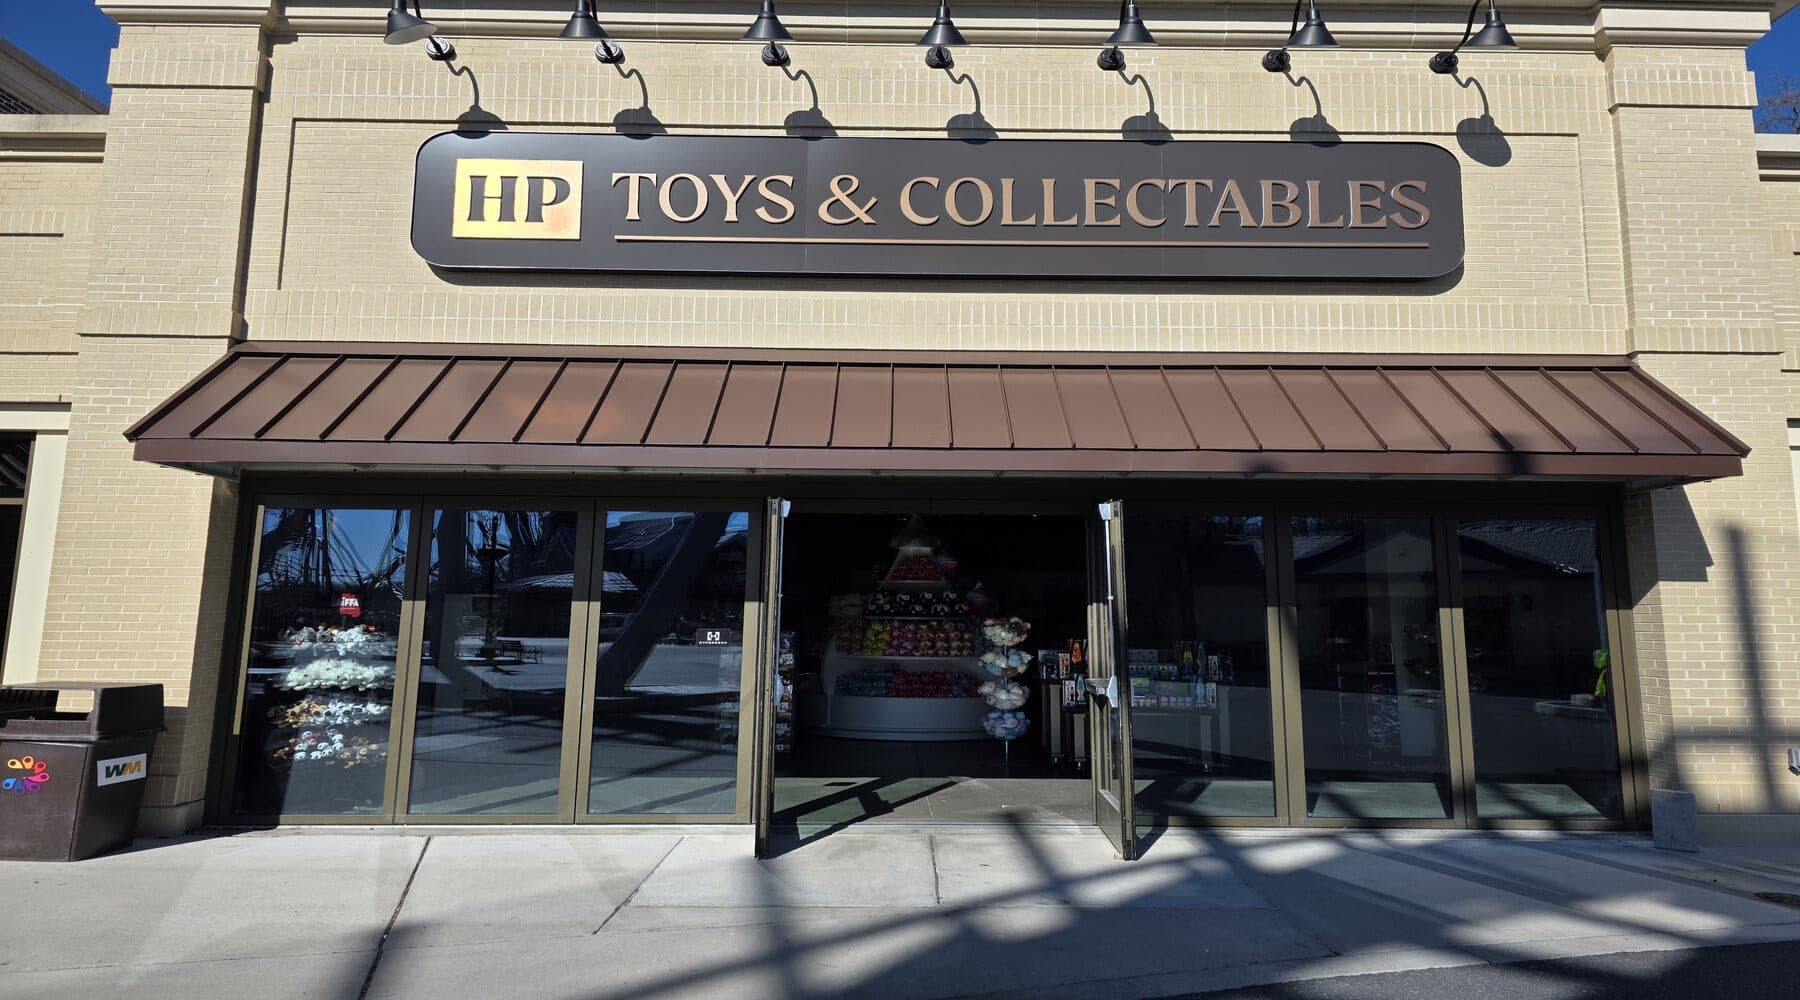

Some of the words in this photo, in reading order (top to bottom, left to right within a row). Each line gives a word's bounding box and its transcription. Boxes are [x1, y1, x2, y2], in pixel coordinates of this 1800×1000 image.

[466, 174, 571, 223] HP
[611, 172, 796, 223] TOYS
[818, 173, 878, 225] &
[899, 175, 1431, 229] COLLECTABLES
[105, 760, 141, 778] WM
